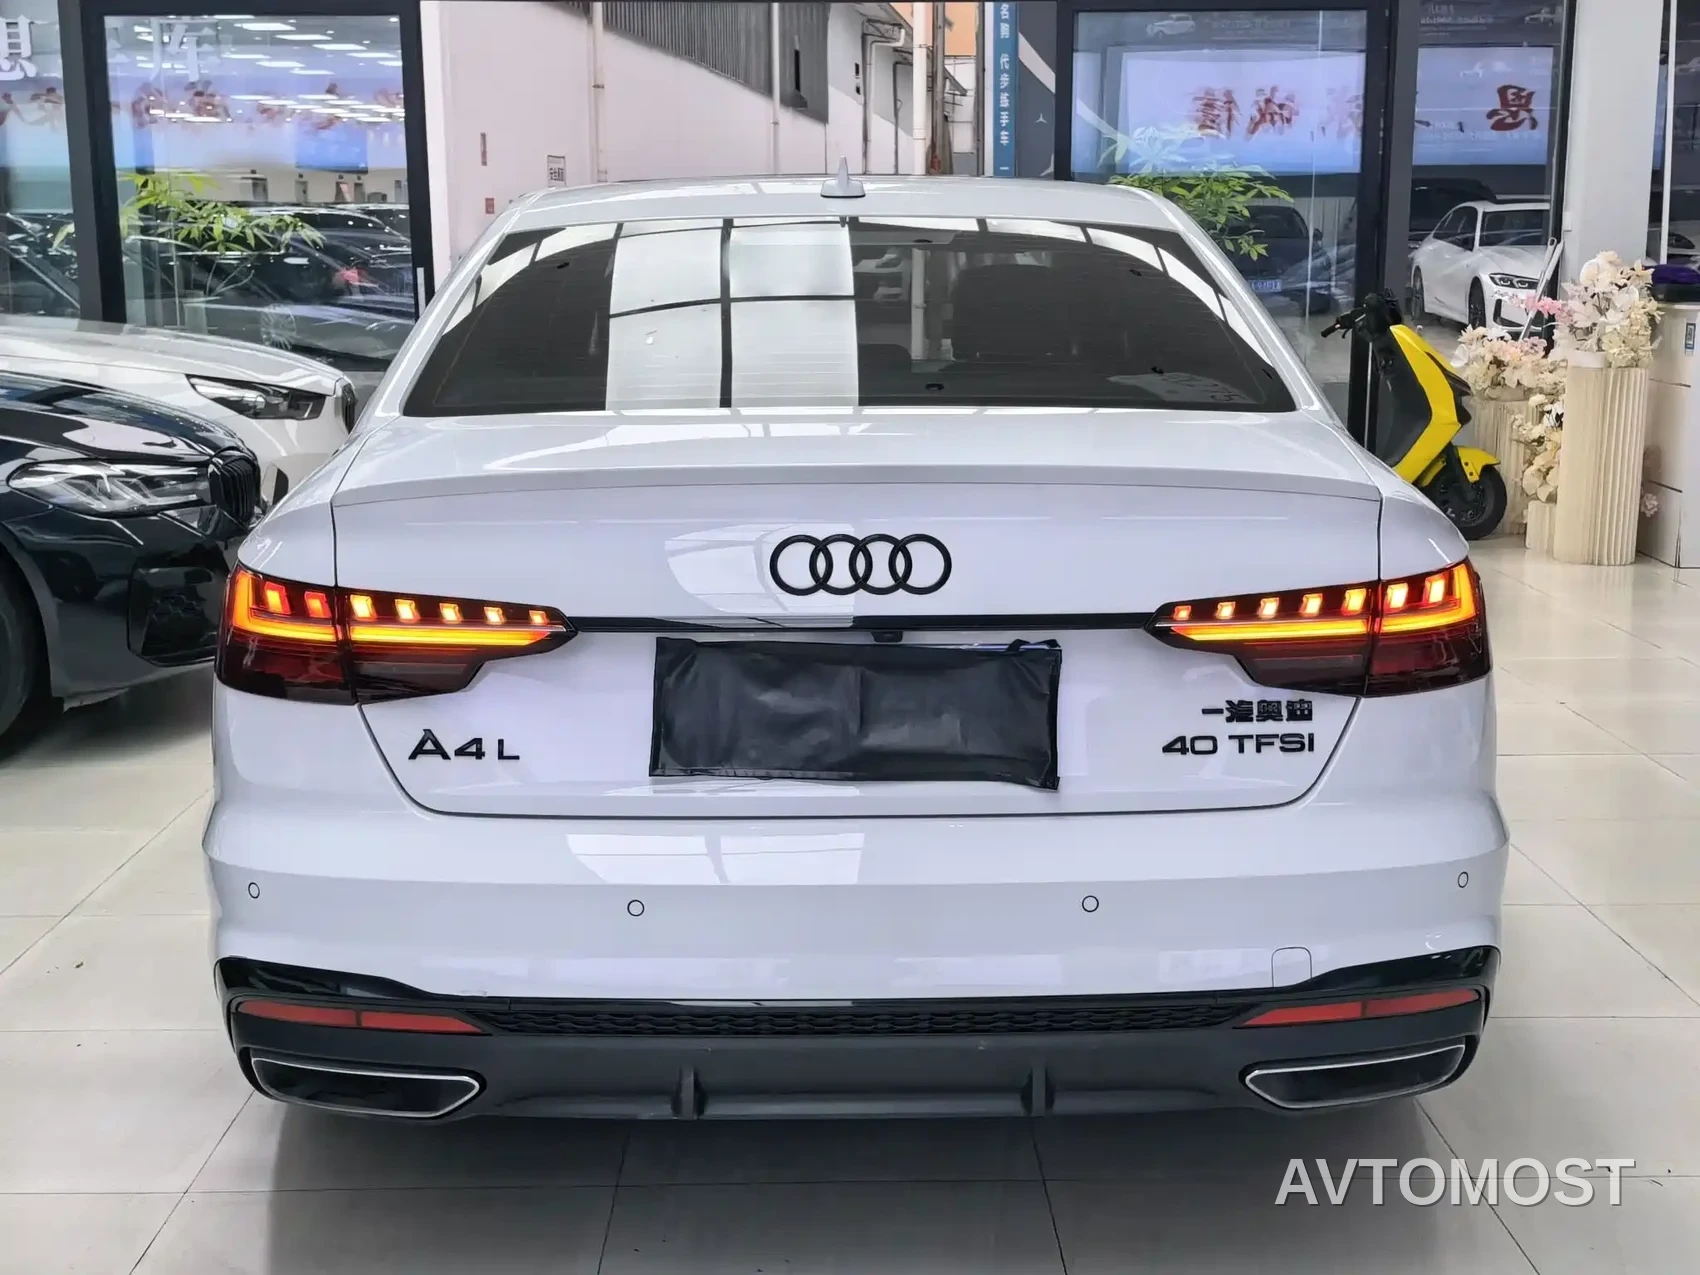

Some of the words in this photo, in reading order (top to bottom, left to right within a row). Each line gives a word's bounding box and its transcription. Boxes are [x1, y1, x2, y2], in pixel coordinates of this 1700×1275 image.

[1201, 698, 1313, 723] 一汽奥迪
[1162, 735, 1218, 756] 40
[1228, 733, 1314, 754] TFSI
